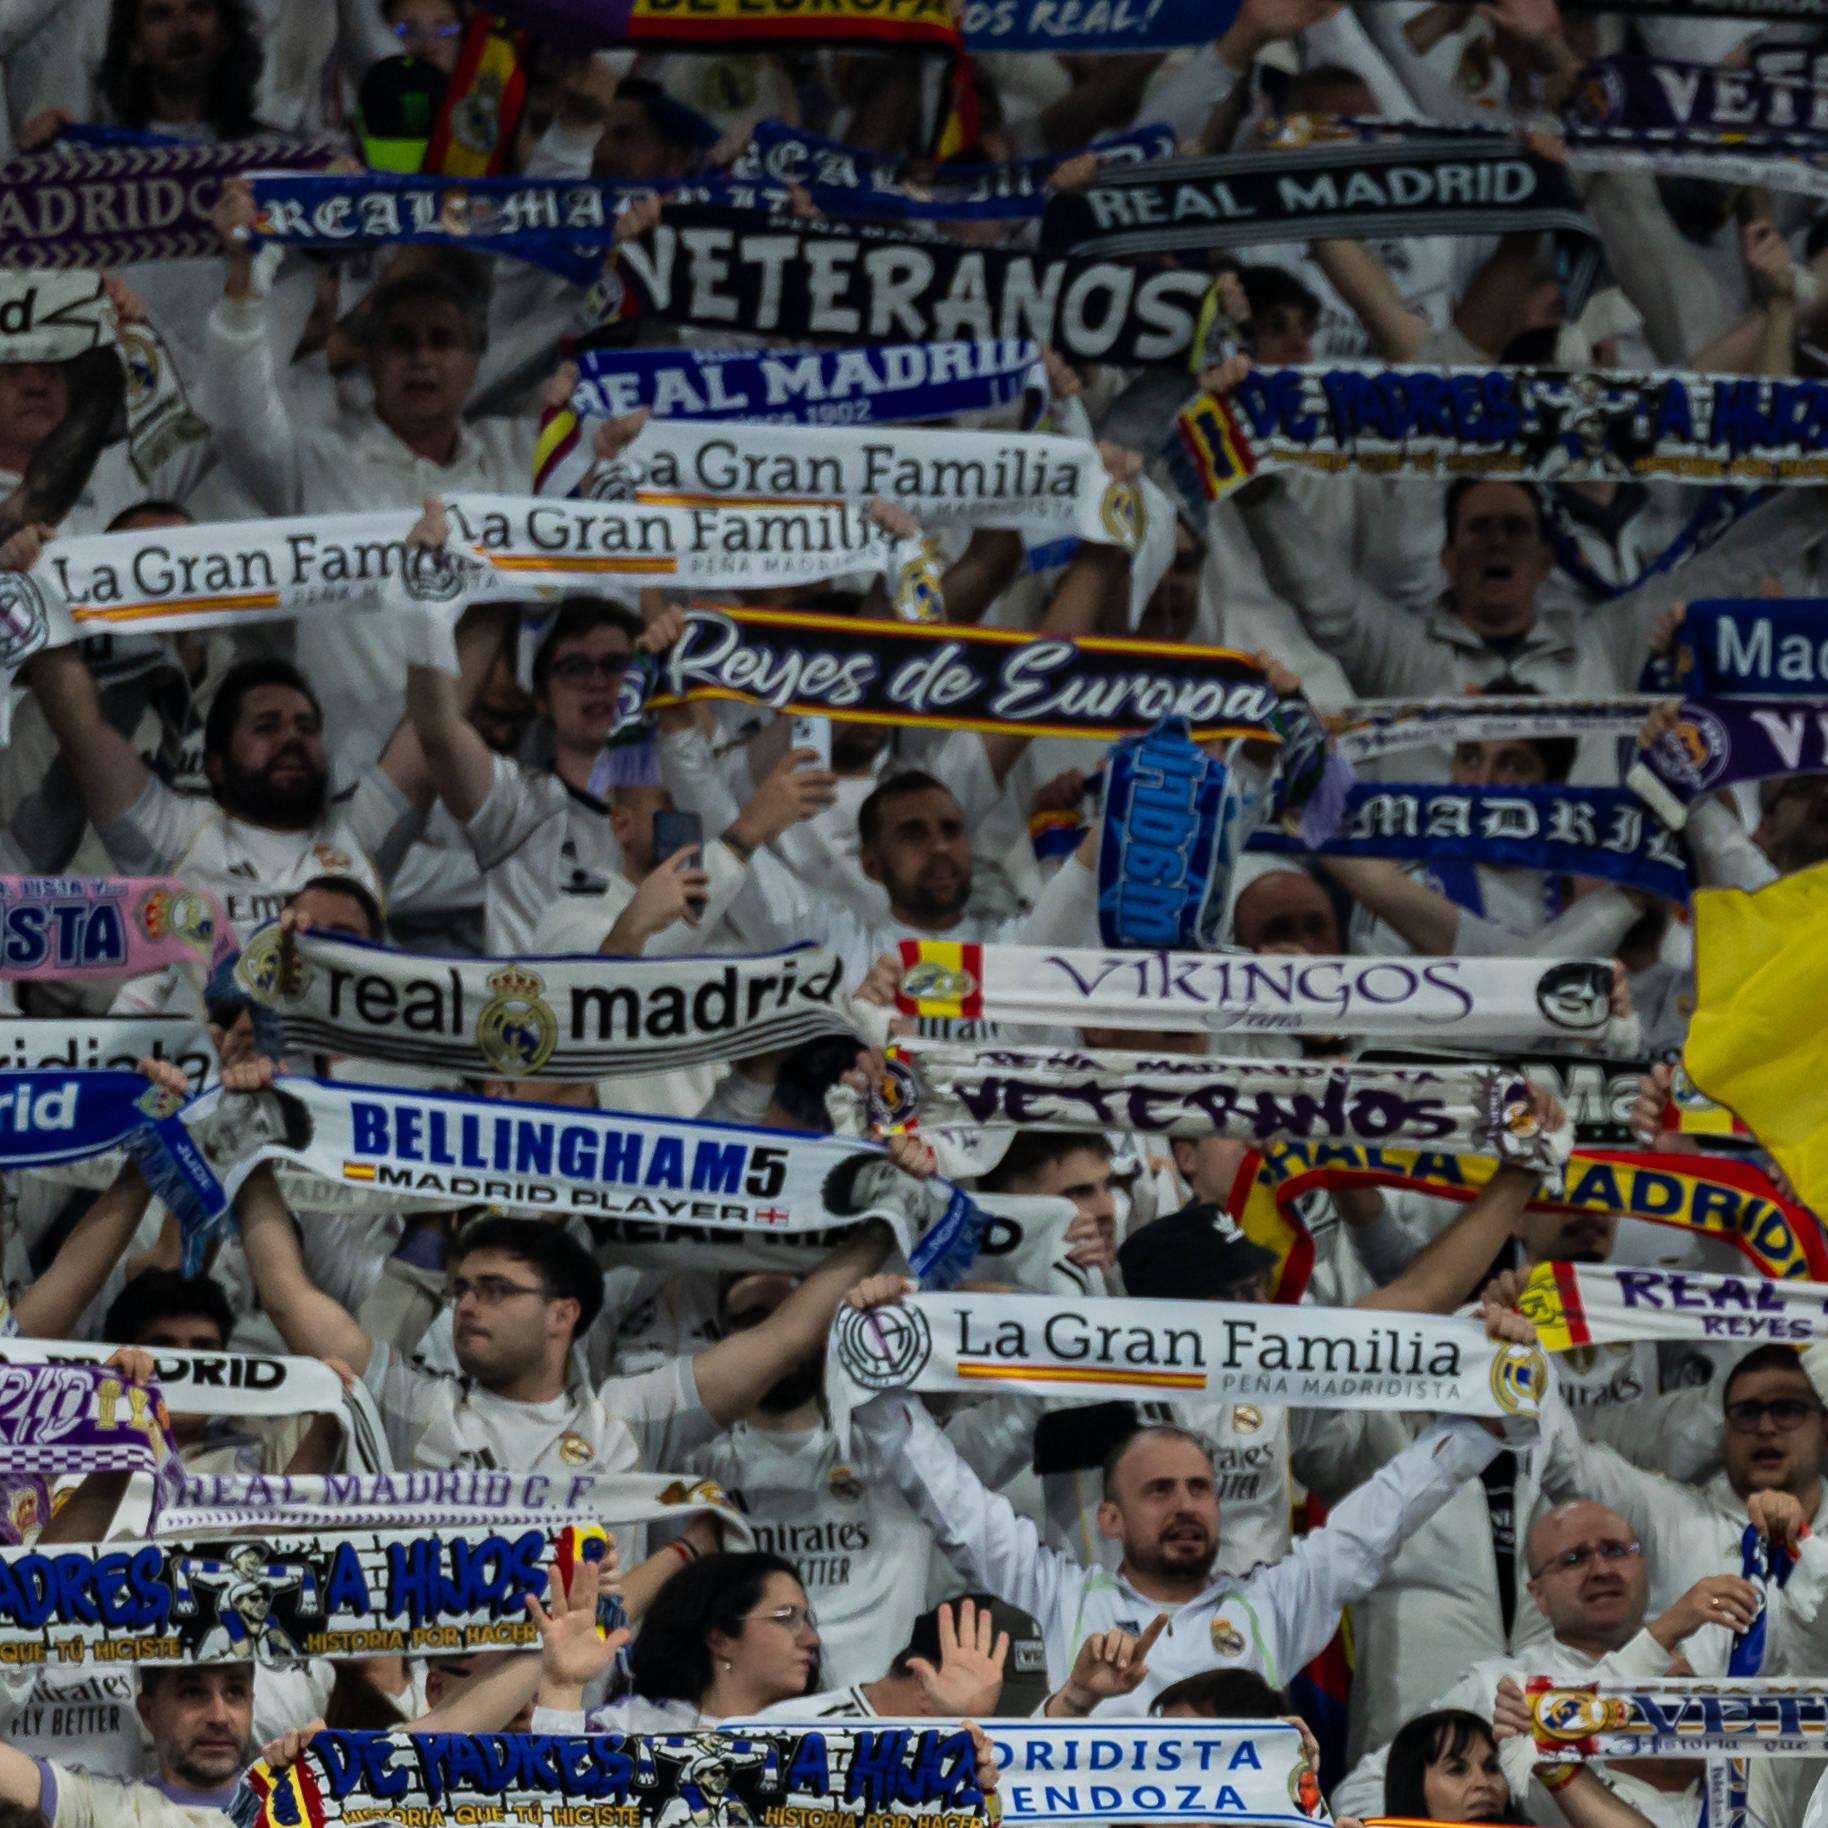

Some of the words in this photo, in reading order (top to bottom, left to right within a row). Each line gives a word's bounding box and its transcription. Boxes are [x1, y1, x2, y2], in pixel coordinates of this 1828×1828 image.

[1093, 180, 1255, 230] REAL
[1275, 158, 1540, 212] MADRID
[620, 225, 1217, 363] VETERANOS
[696, 440, 845, 496] Gran
[860, 444, 1080, 500] Familia
[527, 504, 677, 554] Gran
[52, 555, 119, 604] La
[133, 545, 276, 598] Gran
[664, 608, 880, 710] Reyes
[888, 638, 985, 708] de
[993, 637, 1284, 728] Europa
[327, 964, 465, 1036] real
[569, 955, 842, 1042] madrid
[1045, 948, 1476, 1026] VIKINGOS
[952, 1075, 1459, 1141] VETERANOS
[350, 1100, 747, 1196] BELLINGHAM
[377, 1163, 560, 1203] MADRID
[571, 1188, 750, 1224] PLAYER
[1614, 1270, 1783, 1311] REAL
[956, 1308, 1028, 1360] La
[1043, 1310, 1206, 1370] Gran
[1220, 1320, 1462, 1380] Familia
[1302, 1377, 1463, 1402] MADRIDISTA
[307, 1629, 404, 1653] HISTORIA
[410, 1626, 461, 1649] POR
[465, 1620, 540, 1645] HACER
[454, 1805, 507, 1828] QUE
[511, 1801, 545, 1827] TÚ
[550, 1804, 644, 1828] HICISTE
